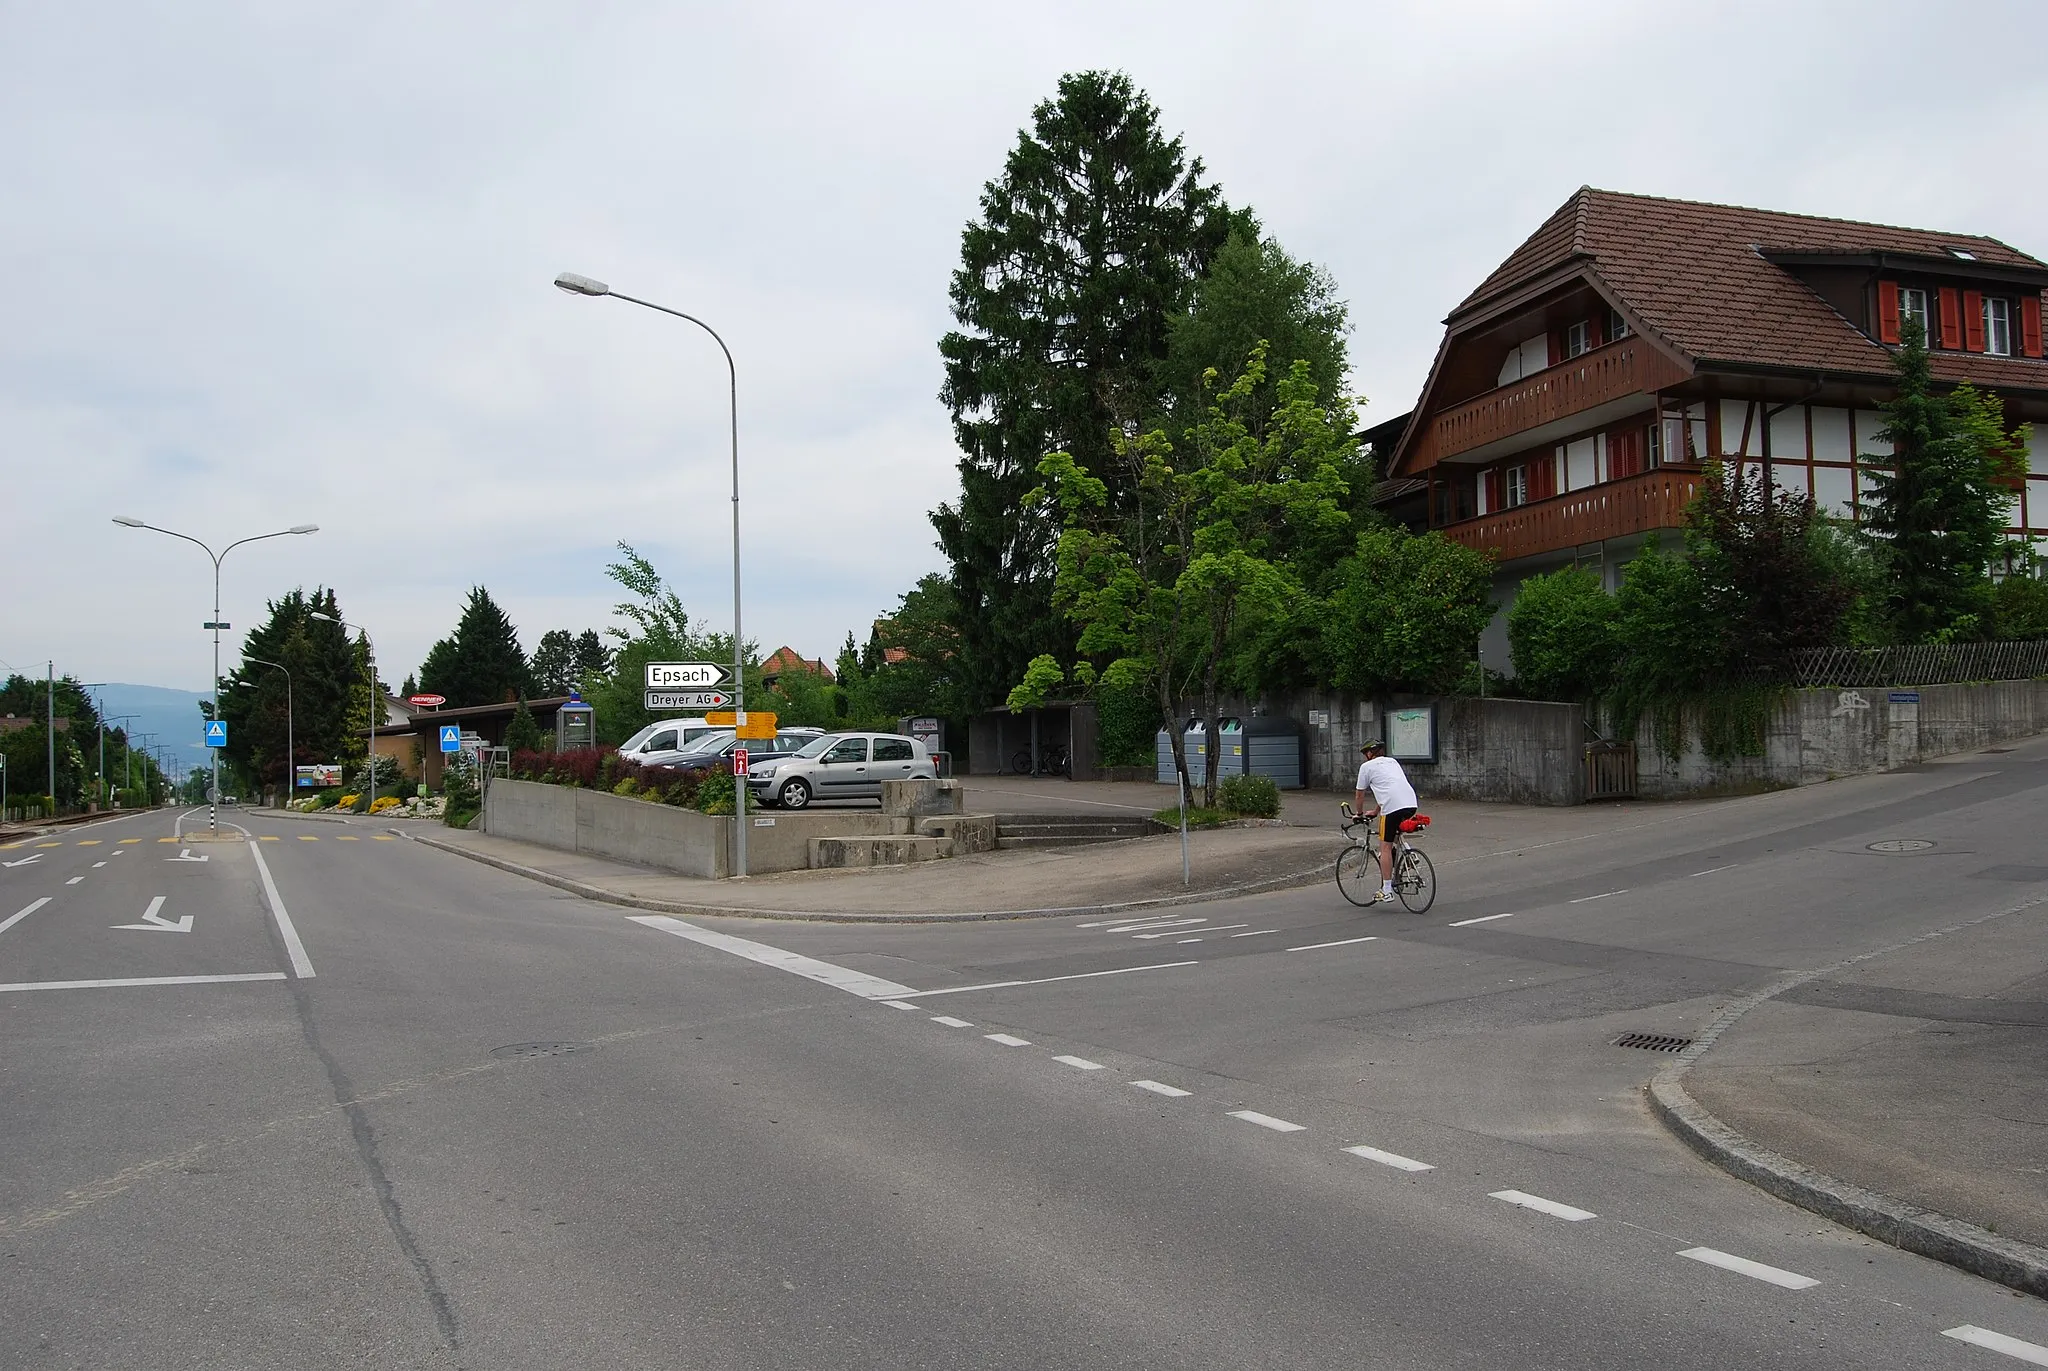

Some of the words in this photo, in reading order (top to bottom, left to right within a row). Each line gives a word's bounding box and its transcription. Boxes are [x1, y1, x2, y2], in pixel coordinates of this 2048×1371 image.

[652, 667, 710, 685] Epsach
[652, 694, 690, 707] Dreyer
[696, 694, 711, 704] AG
